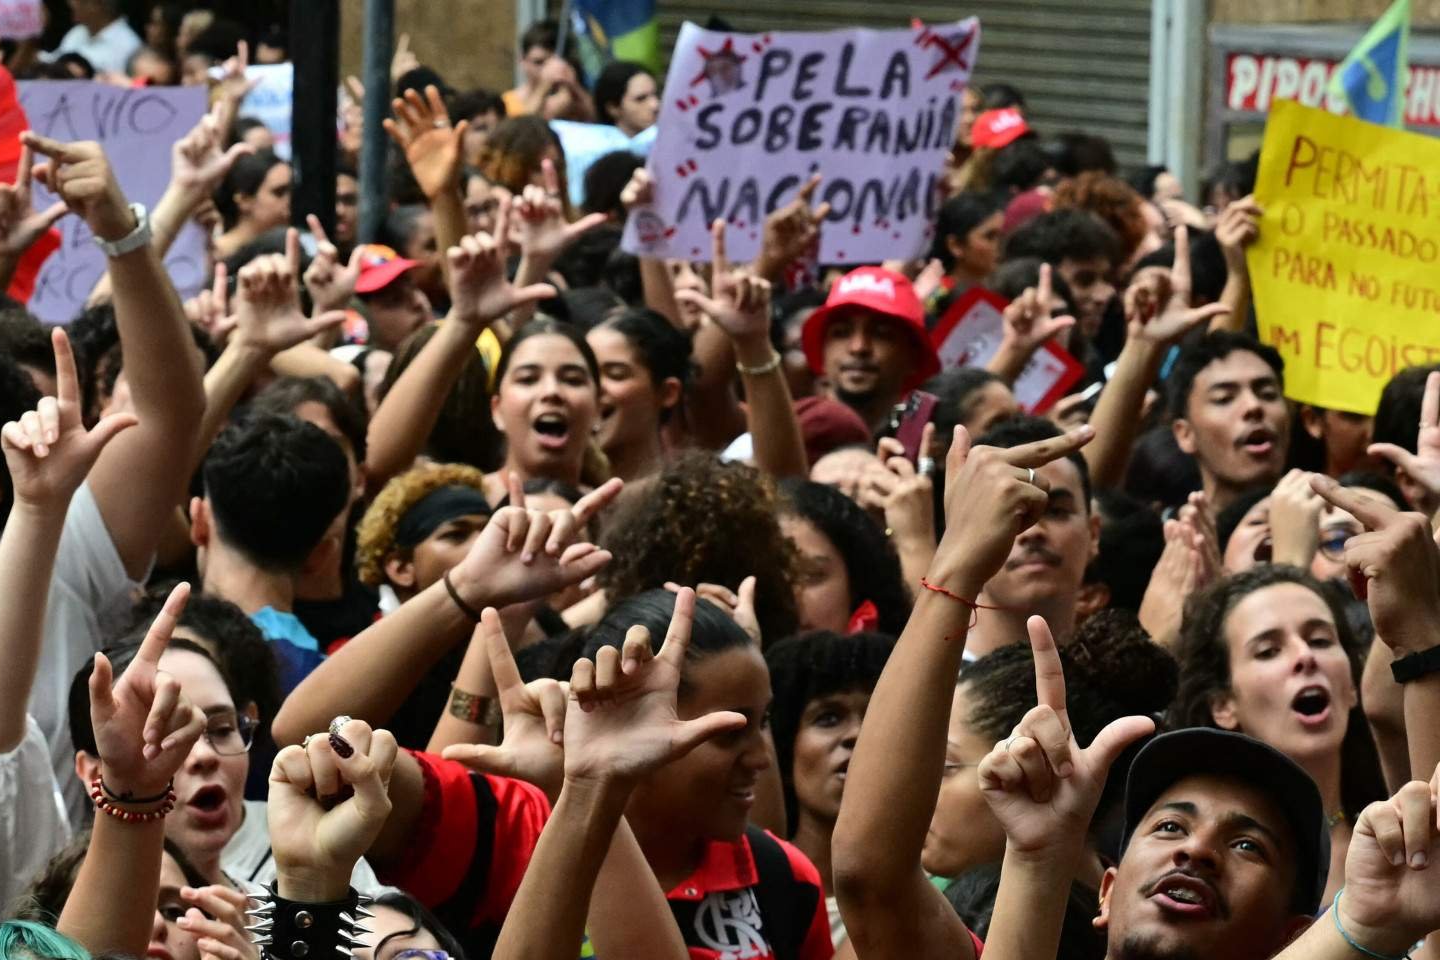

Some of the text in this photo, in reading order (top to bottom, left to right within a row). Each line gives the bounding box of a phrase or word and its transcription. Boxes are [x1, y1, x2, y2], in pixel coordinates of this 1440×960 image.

[754, 42, 909, 101] PELA
[1281, 202, 1439, 263] O PASSADO
[1273, 246, 1337, 291] PARA
[1348, 270, 1381, 302] NO
